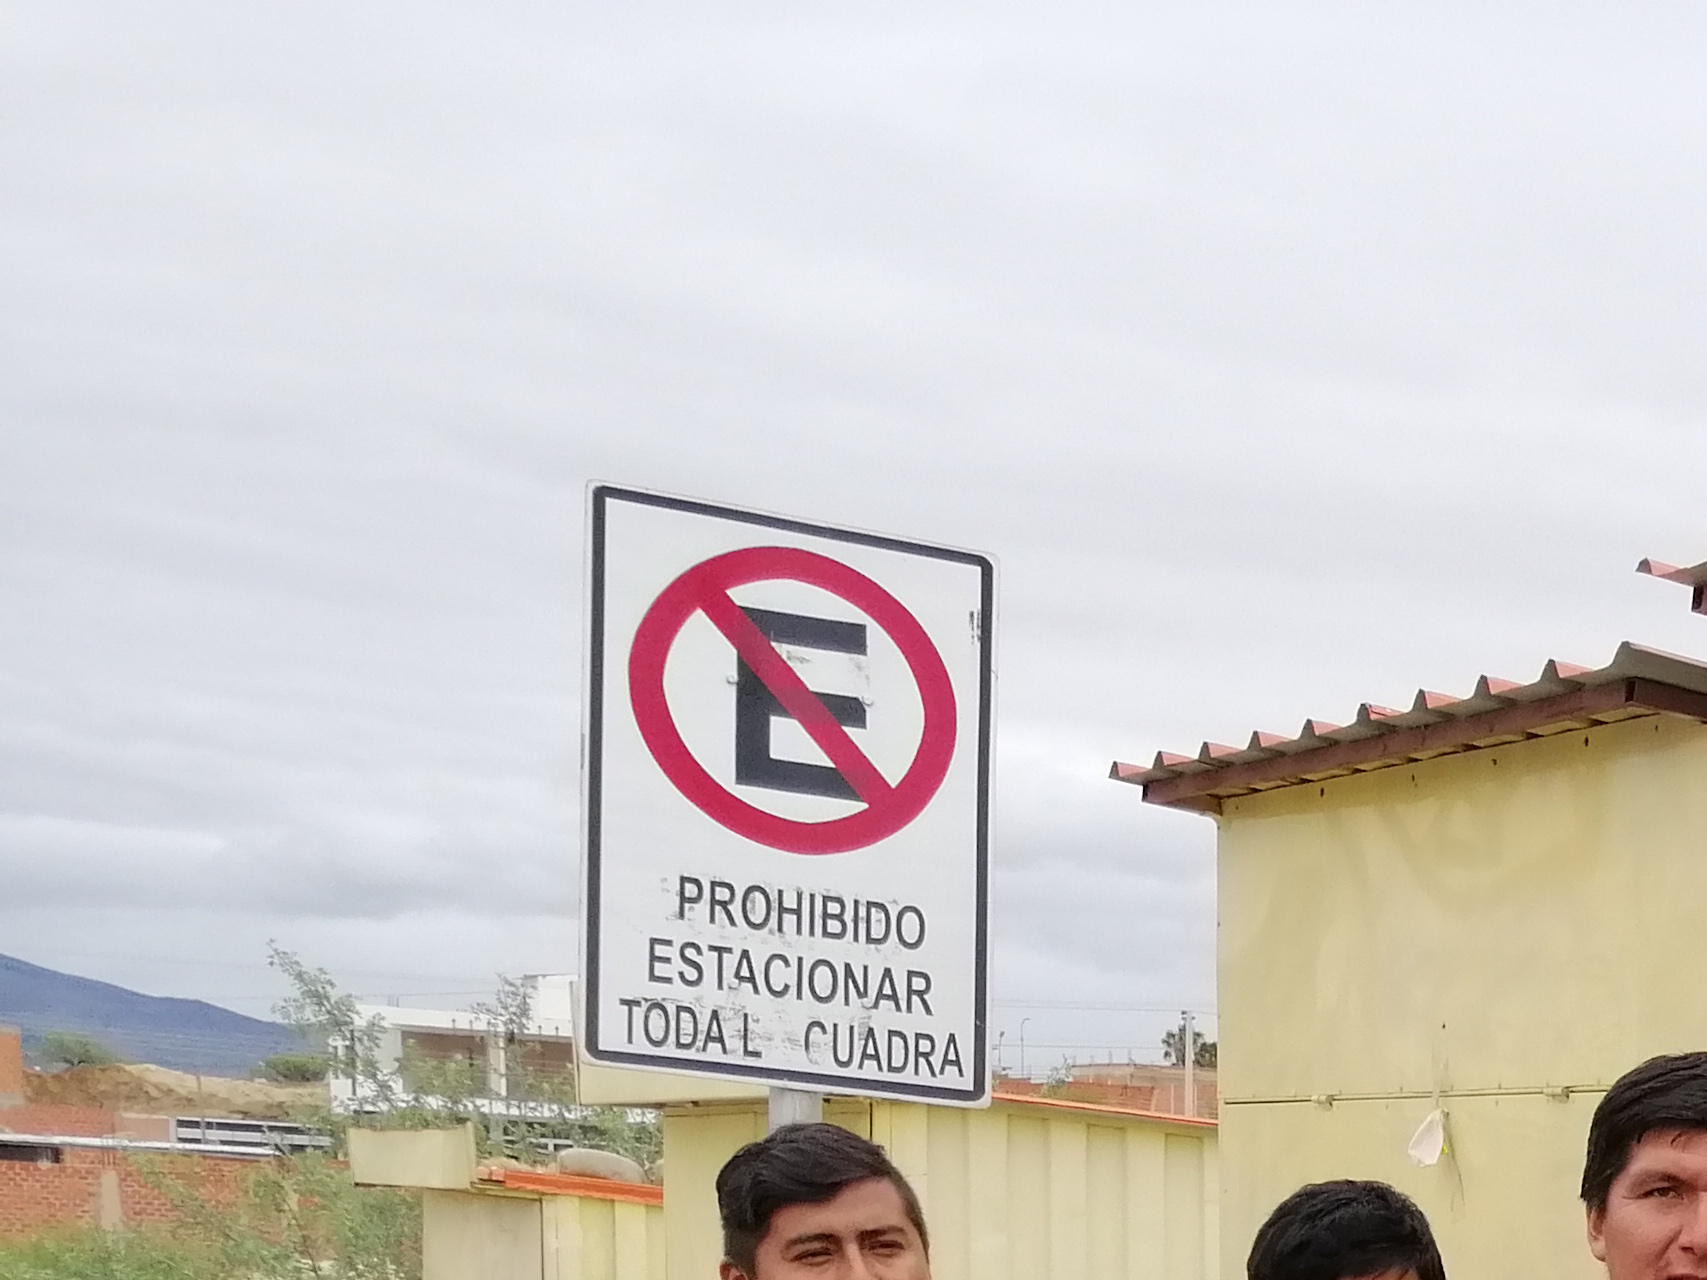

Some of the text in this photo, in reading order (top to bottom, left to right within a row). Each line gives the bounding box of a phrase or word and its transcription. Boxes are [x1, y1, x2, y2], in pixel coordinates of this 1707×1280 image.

[678, 875, 926, 950] PROHIBIDO
[648, 937, 933, 1016] ESTACIONAR
[619, 998, 729, 1055] TODA
[804, 1021, 965, 1078] CUADRA
